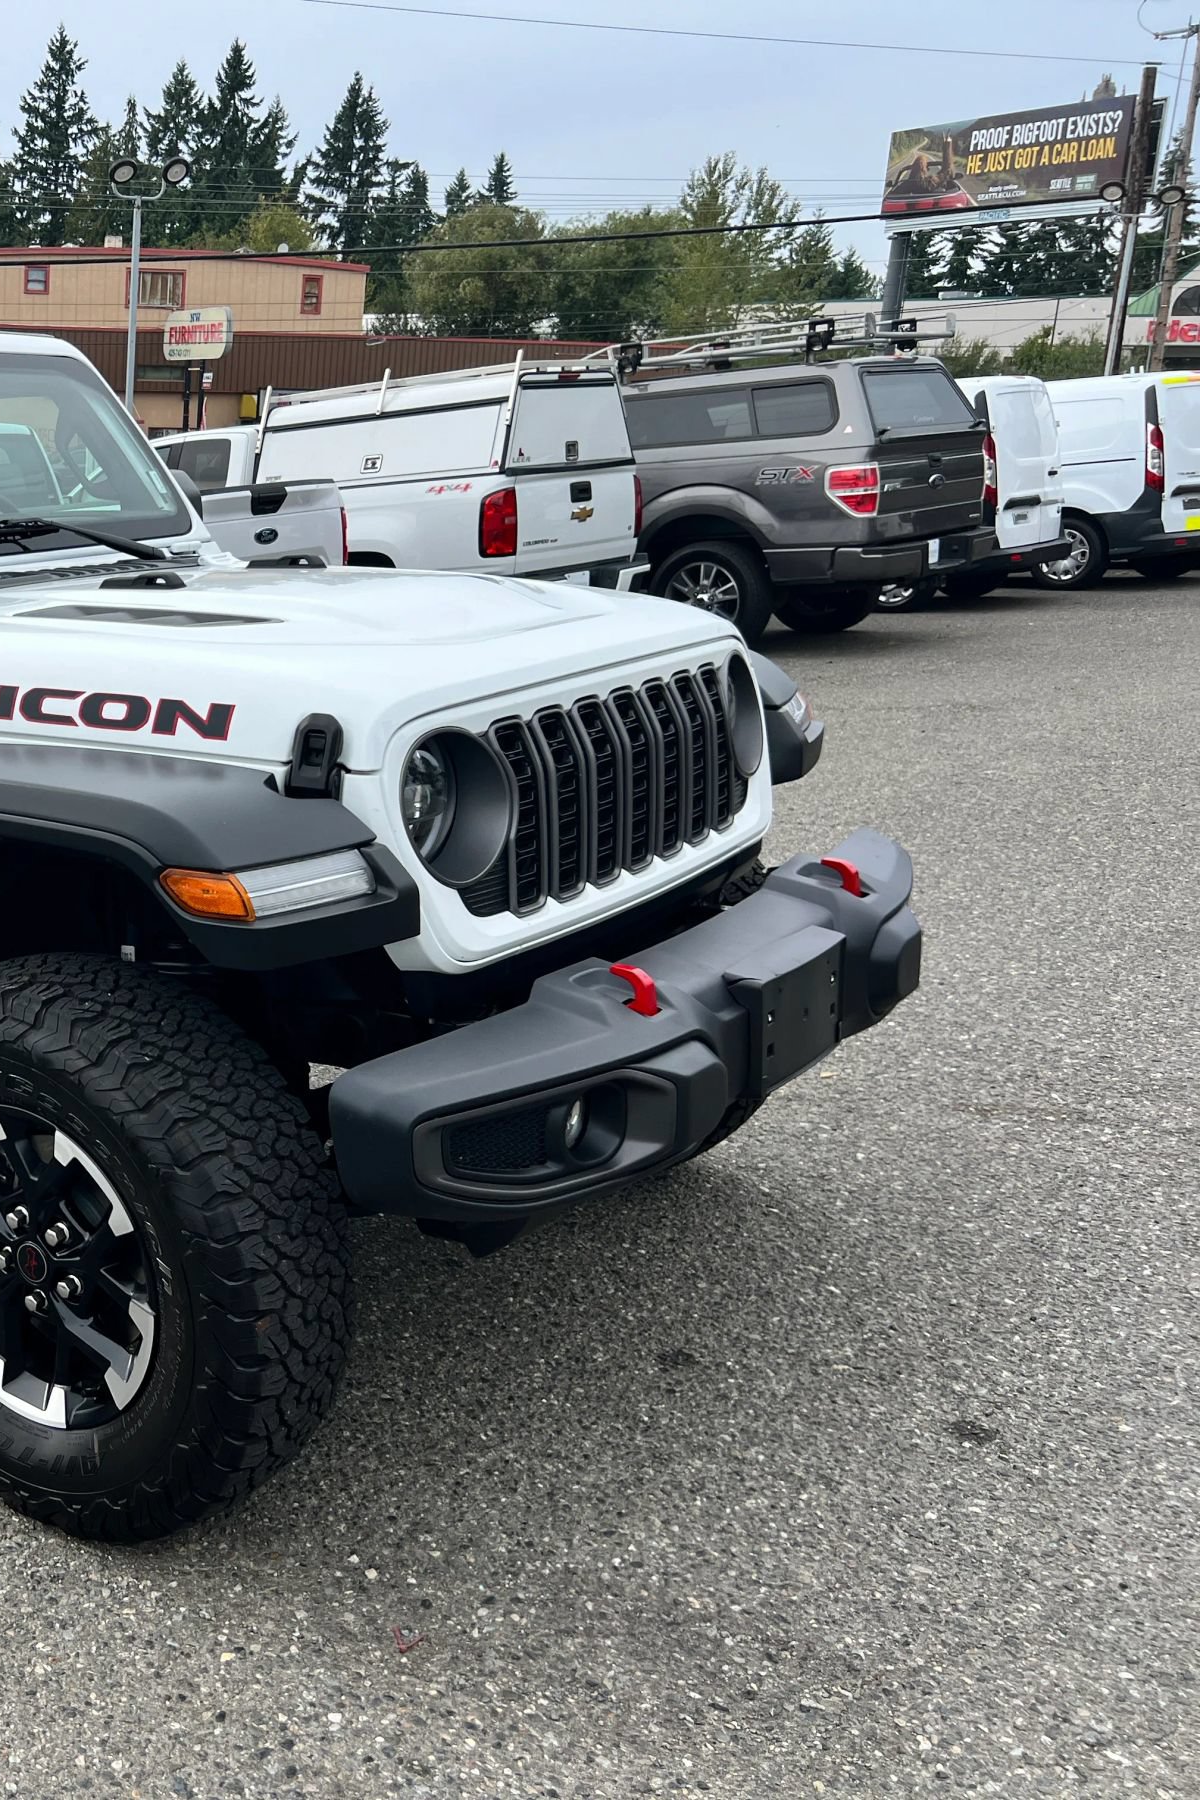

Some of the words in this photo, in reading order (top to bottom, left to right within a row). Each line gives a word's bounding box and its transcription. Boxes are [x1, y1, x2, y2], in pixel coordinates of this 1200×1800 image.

[969, 126, 1011, 151] PROOF
[1011, 118, 1067, 146] BIGFOOT
[1066, 110, 1123, 138] EXISTS?
[966, 154, 984, 175] HE
[983, 150, 1015, 173] JUST
[1014, 146, 1040, 169] GOT
[1039, 145, 1049, 166] A
[1051, 141, 1078, 164] CAR
[1079, 137, 1117, 161] LOAN.
[189, 312, 201, 322] NW
[168, 322, 224, 346] FURNITURE
[512, 455, 531, 464] LEER
[758, 464, 821, 481] STX
